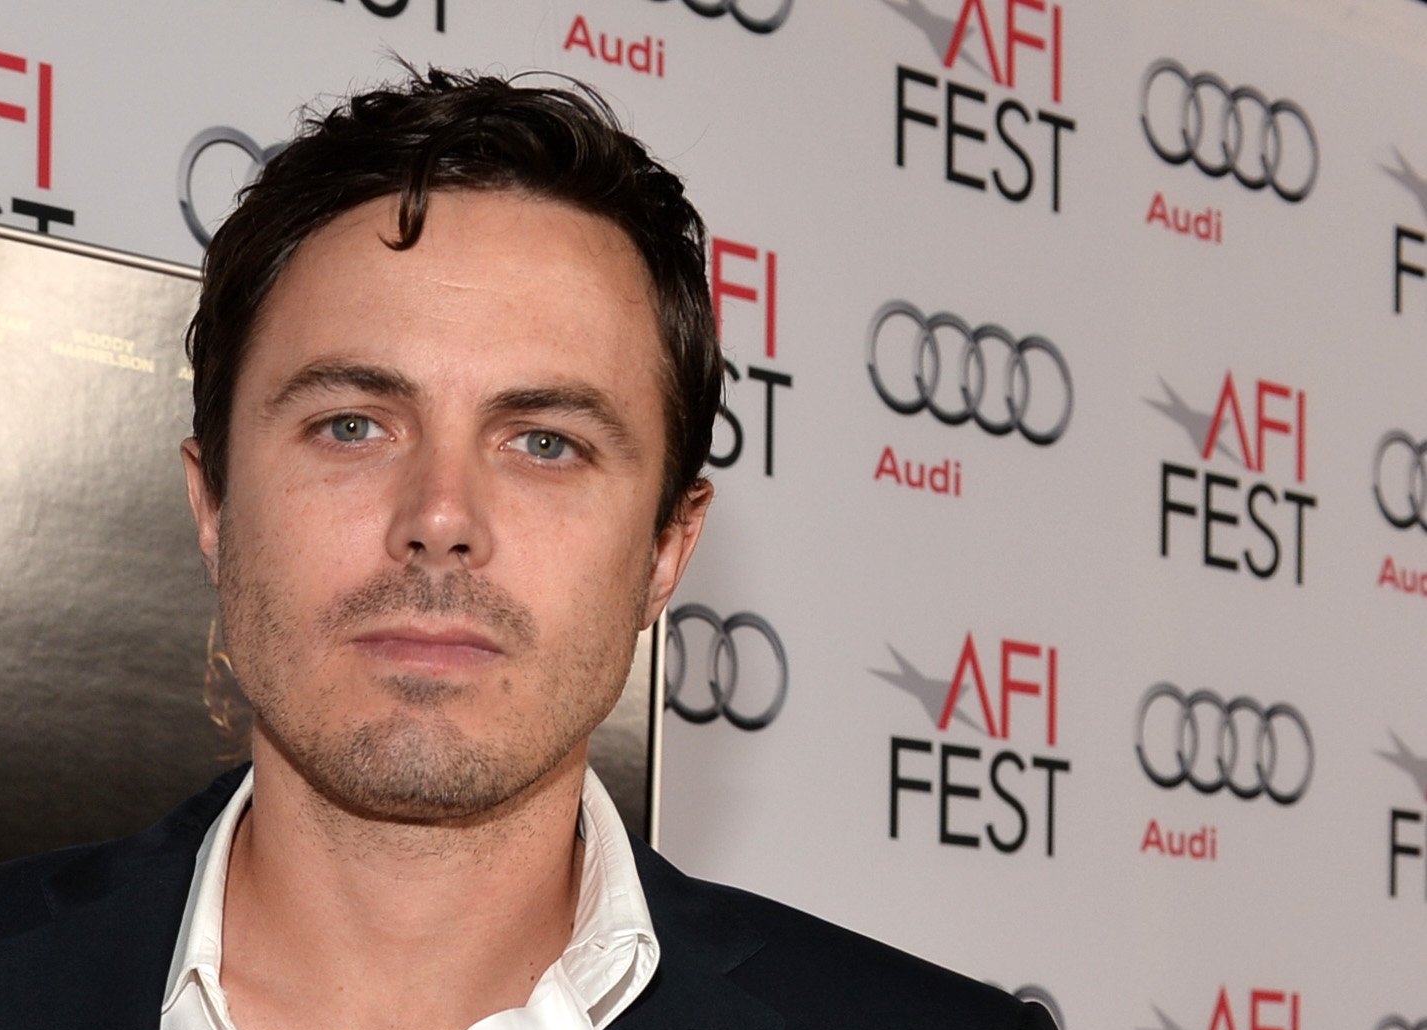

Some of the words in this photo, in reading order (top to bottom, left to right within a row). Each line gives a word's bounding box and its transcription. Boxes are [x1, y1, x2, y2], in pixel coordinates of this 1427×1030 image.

[563, 15, 666, 78] Audi
[943, 0, 1063, 104] AFI
[895, 65, 1076, 213] FEST
[1146, 193, 1223, 244] Audi
[711, 236, 778, 359] FI
[708, 357, 793, 477] ST
[874, 446, 962, 497] Audi
[1201, 370, 1306, 483] AFI
[1160, 461, 1317, 585] FEST
[937, 631, 1058, 747] AFI
[889, 736, 1070, 858] FEST
[1141, 820, 1218, 861] Audi
